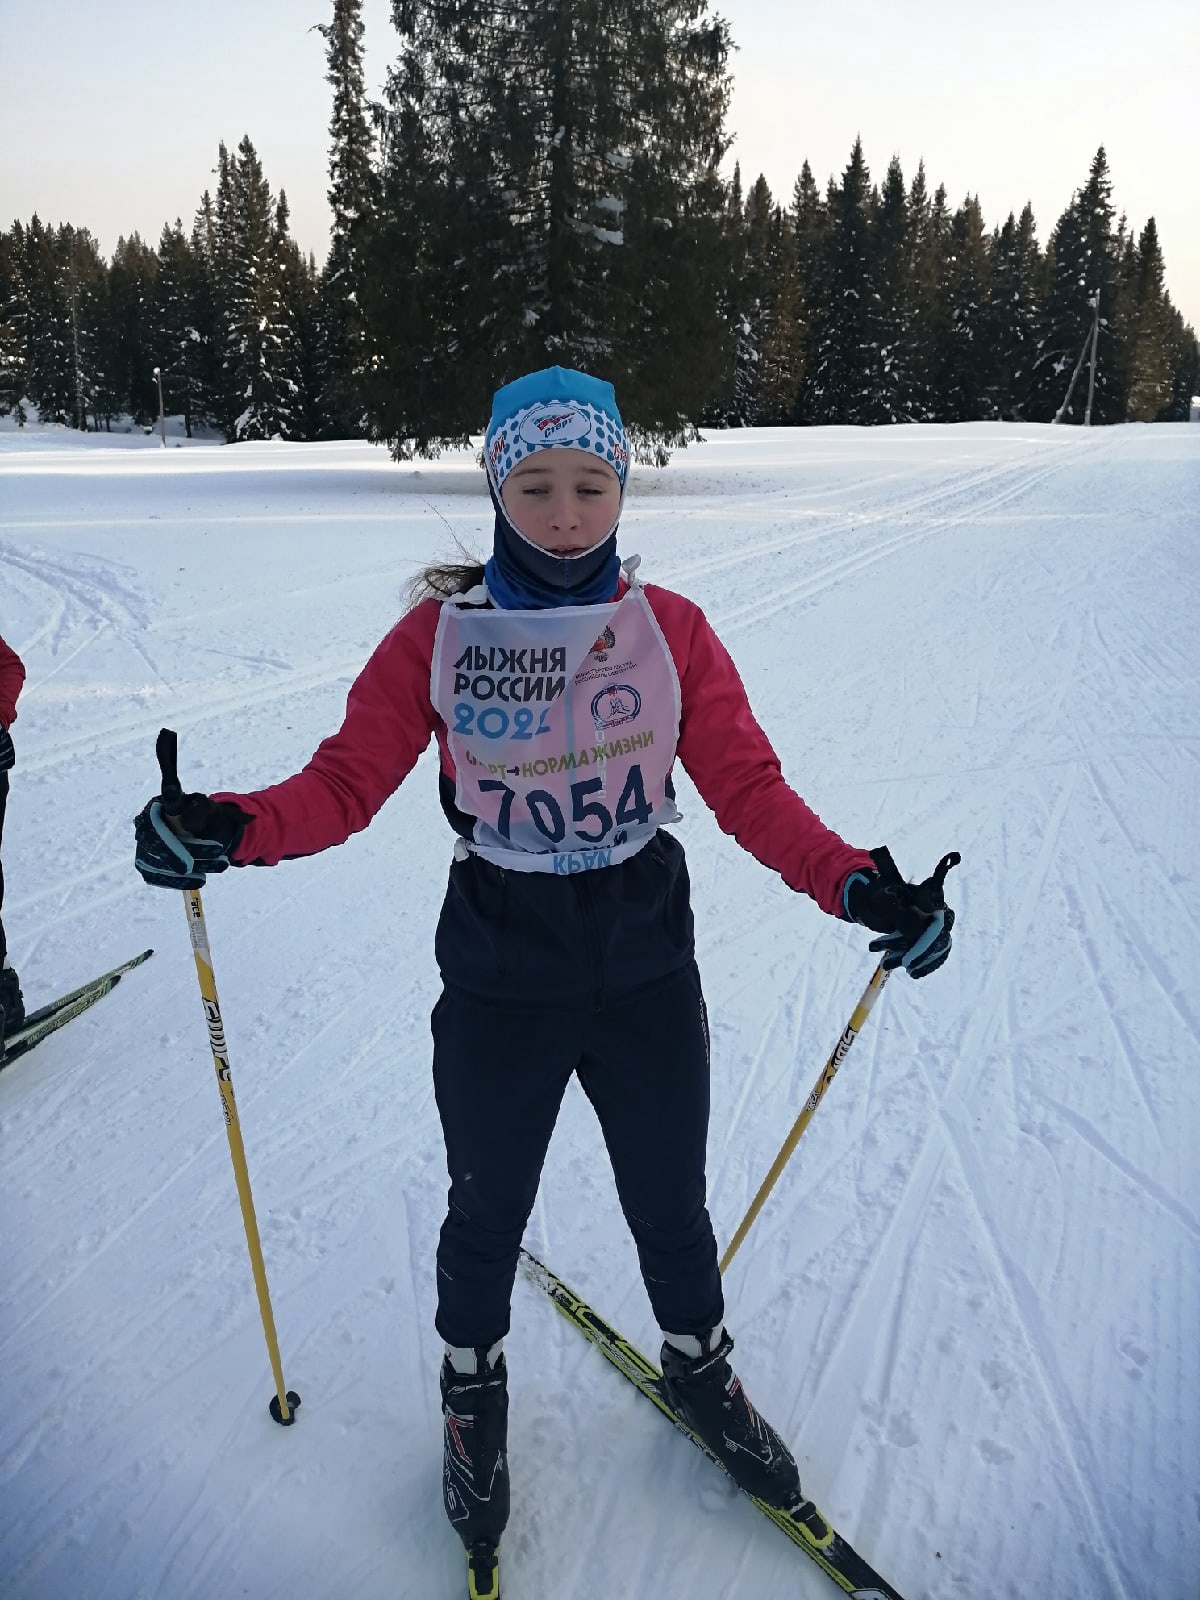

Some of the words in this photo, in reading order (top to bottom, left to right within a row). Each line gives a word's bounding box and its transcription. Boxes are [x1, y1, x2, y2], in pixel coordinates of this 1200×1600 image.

[453, 645, 566, 673] ЛЫЖНЯ
[453, 672, 566, 702] РОССИИ
[522, 749, 590, 778] НОРМА
[590, 730, 655, 763] ЖИЗНИ
[477, 764, 653, 844] 7054
